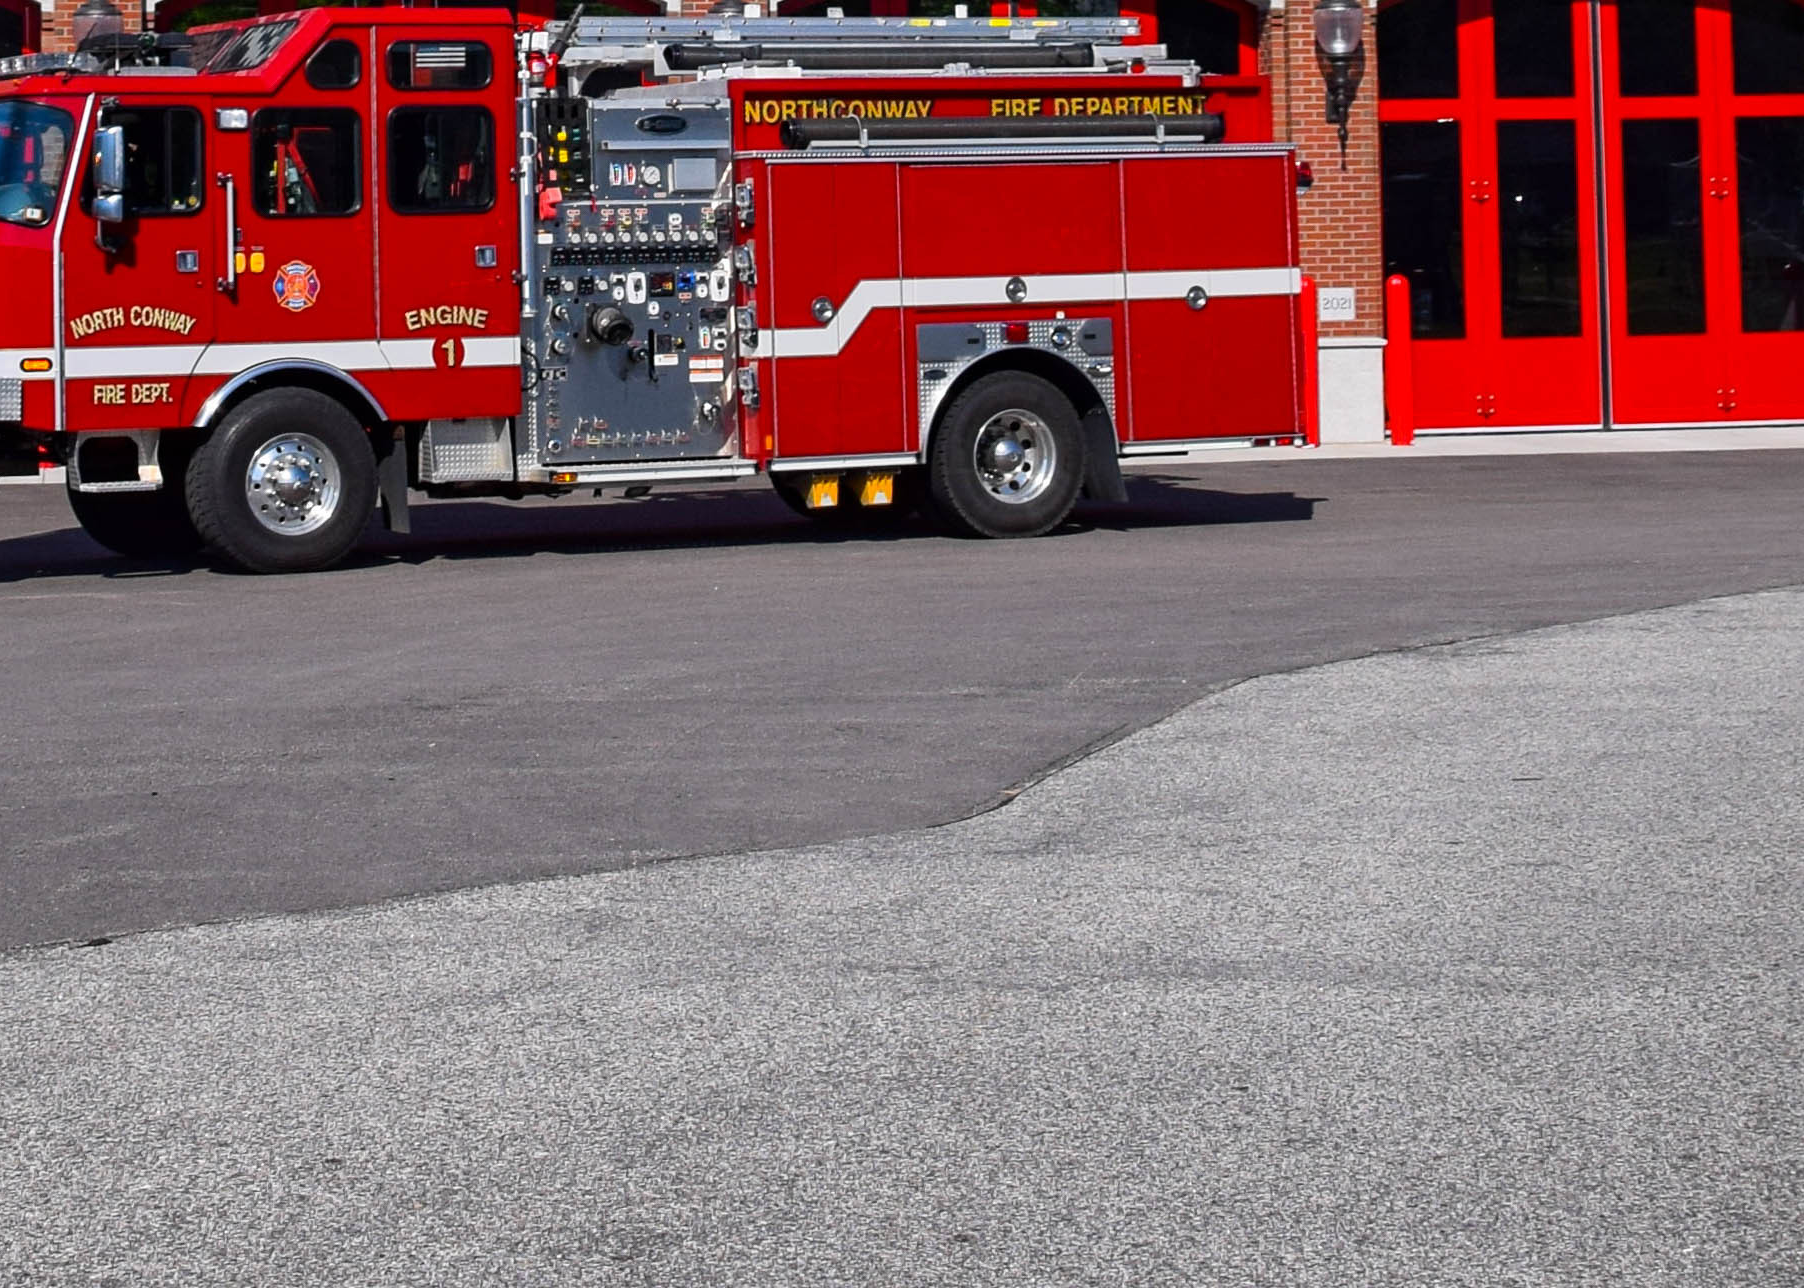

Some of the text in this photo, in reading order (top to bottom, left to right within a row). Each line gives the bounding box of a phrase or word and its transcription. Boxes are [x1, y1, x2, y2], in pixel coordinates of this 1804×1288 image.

[744, 99, 932, 124] NORTH CONWAY
[991, 95, 1206, 117] FIRE DEPARTMENT
[1323, 297, 1352, 310] 2021
[70, 306, 197, 339] NORTH CONWAY
[405, 306, 489, 331] ENGINE
[441, 339, 455, 367] 1
[93, 383, 173, 404] FIRE DEPT.
